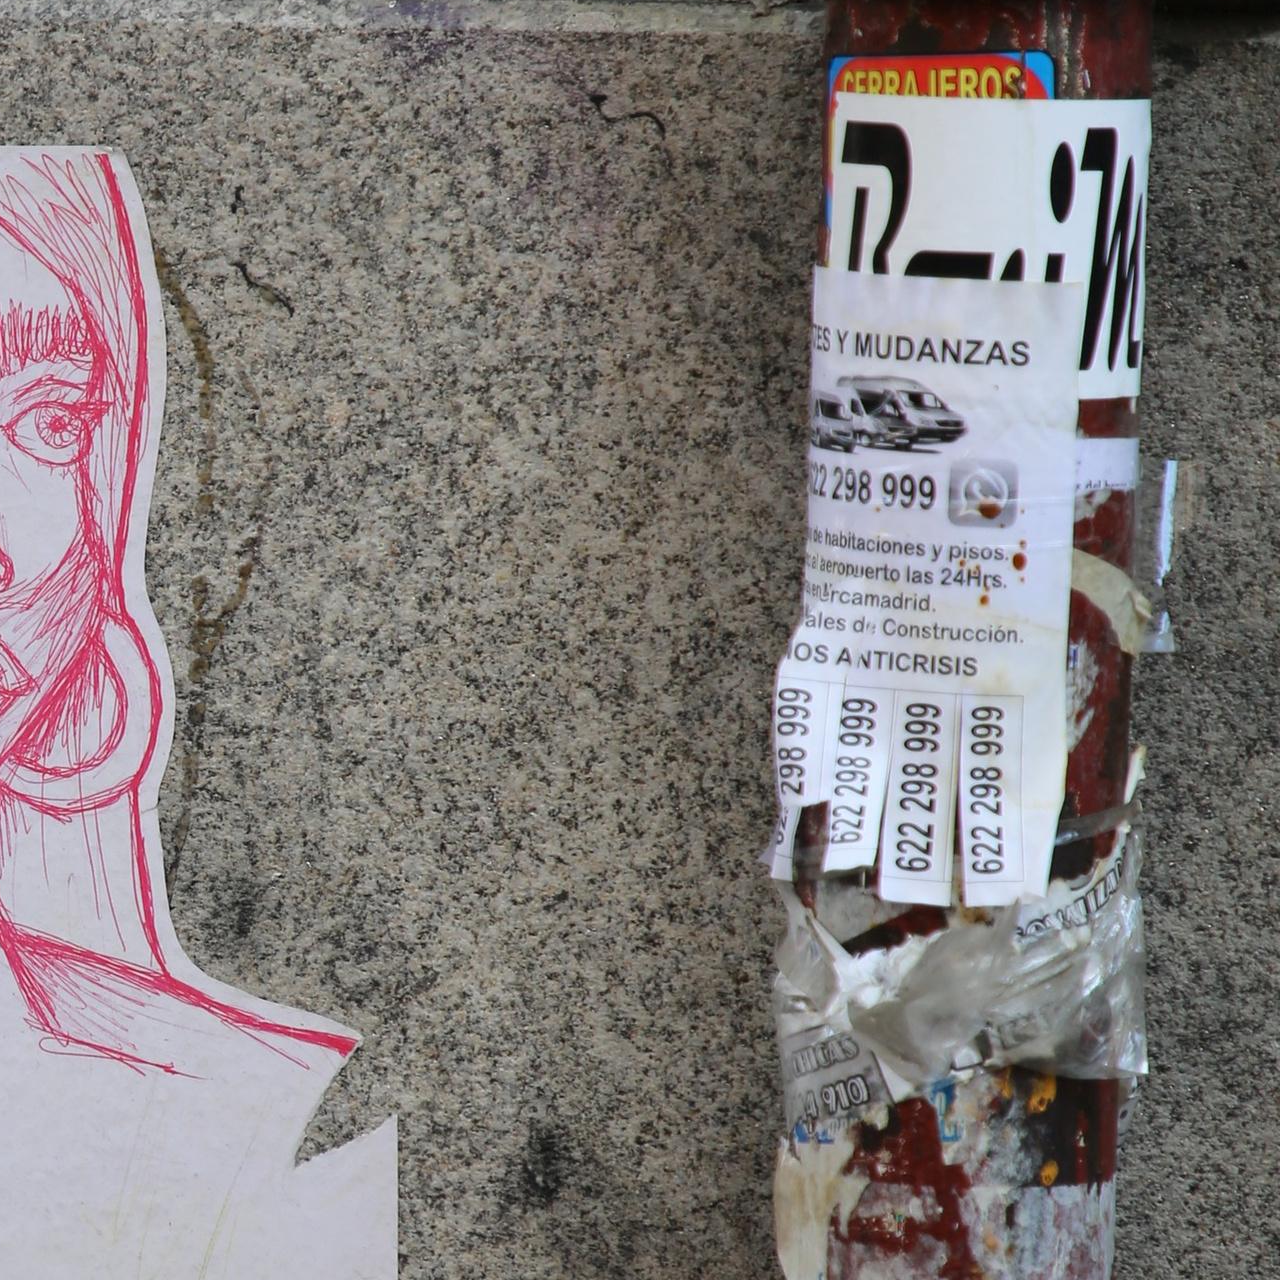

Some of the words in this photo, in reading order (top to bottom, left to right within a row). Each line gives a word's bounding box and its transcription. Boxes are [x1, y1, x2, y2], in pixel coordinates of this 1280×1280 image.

[837, 329, 849, 354] Y
[855, 332, 1031, 367] MUDANZAS
[832, 467, 872, 504] 298
[882, 473, 937, 510] 999
[825, 529, 926, 557] habitaciones
[932, 543, 943, 562] y
[949, 541, 1010, 562] pisos.
[820, 558, 900, 583] aeropuerto
[907, 566, 934, 585] las
[940, 568, 1008, 589] 24Hrs.
[883, 618, 1024, 644] Construcción.
[836, 647, 978, 677] ANTICRISIS
[777, 687, 813, 737] 999
[839, 698, 878, 748] 999
[904, 702, 942, 753] 999
[970, 705, 1005, 756] 999
[778, 747, 806, 796] 298
[834, 755, 872, 797] 298
[900, 763, 940, 814] 298
[970, 767, 1003, 817] 298
[831, 799, 865, 845] 622
[895, 821, 935, 873] 622
[972, 827, 1004, 874] 622
